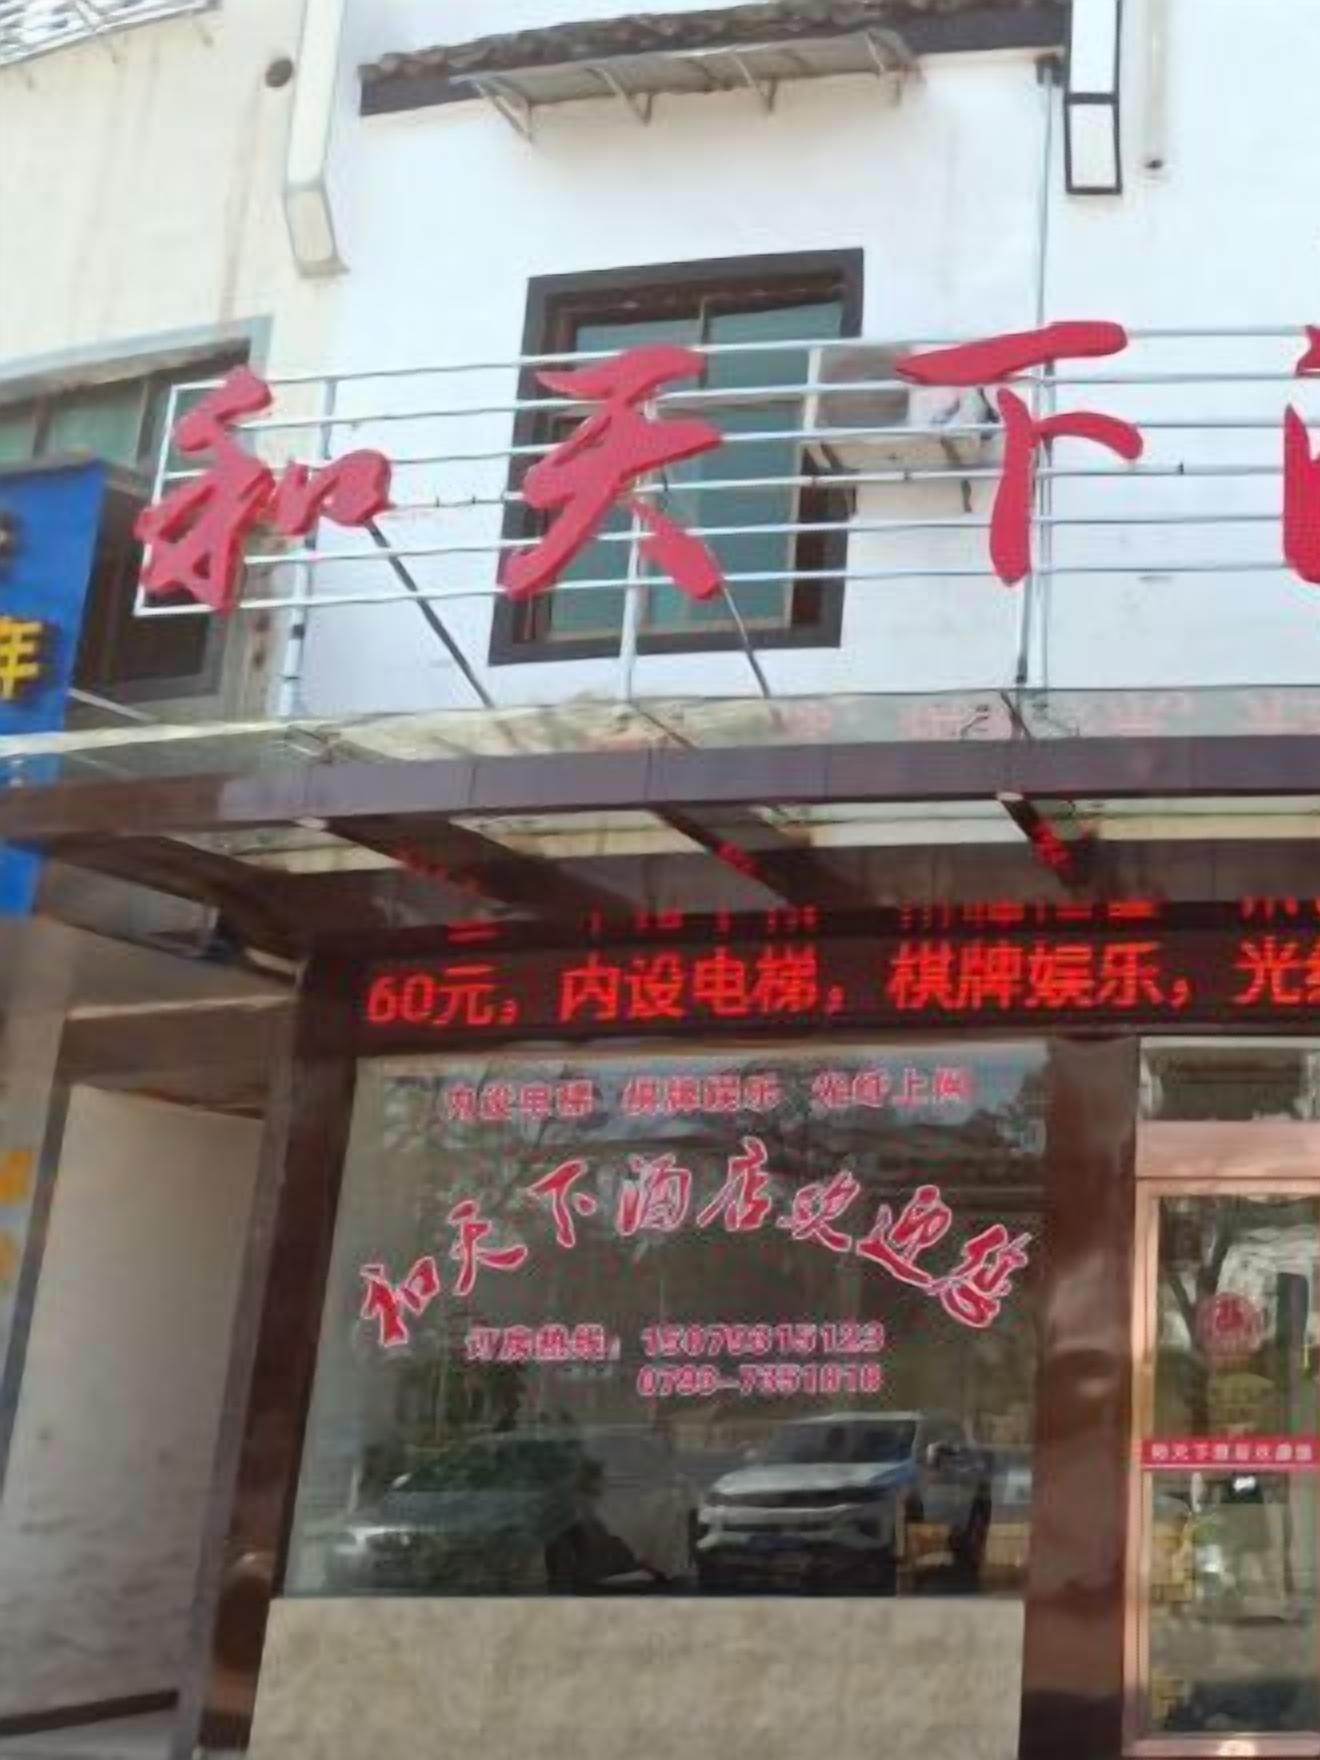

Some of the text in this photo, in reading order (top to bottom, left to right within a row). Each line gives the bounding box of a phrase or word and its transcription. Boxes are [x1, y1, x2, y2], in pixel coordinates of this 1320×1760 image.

[361, 1136, 1032, 1348] 和天下酒店欢迎您
